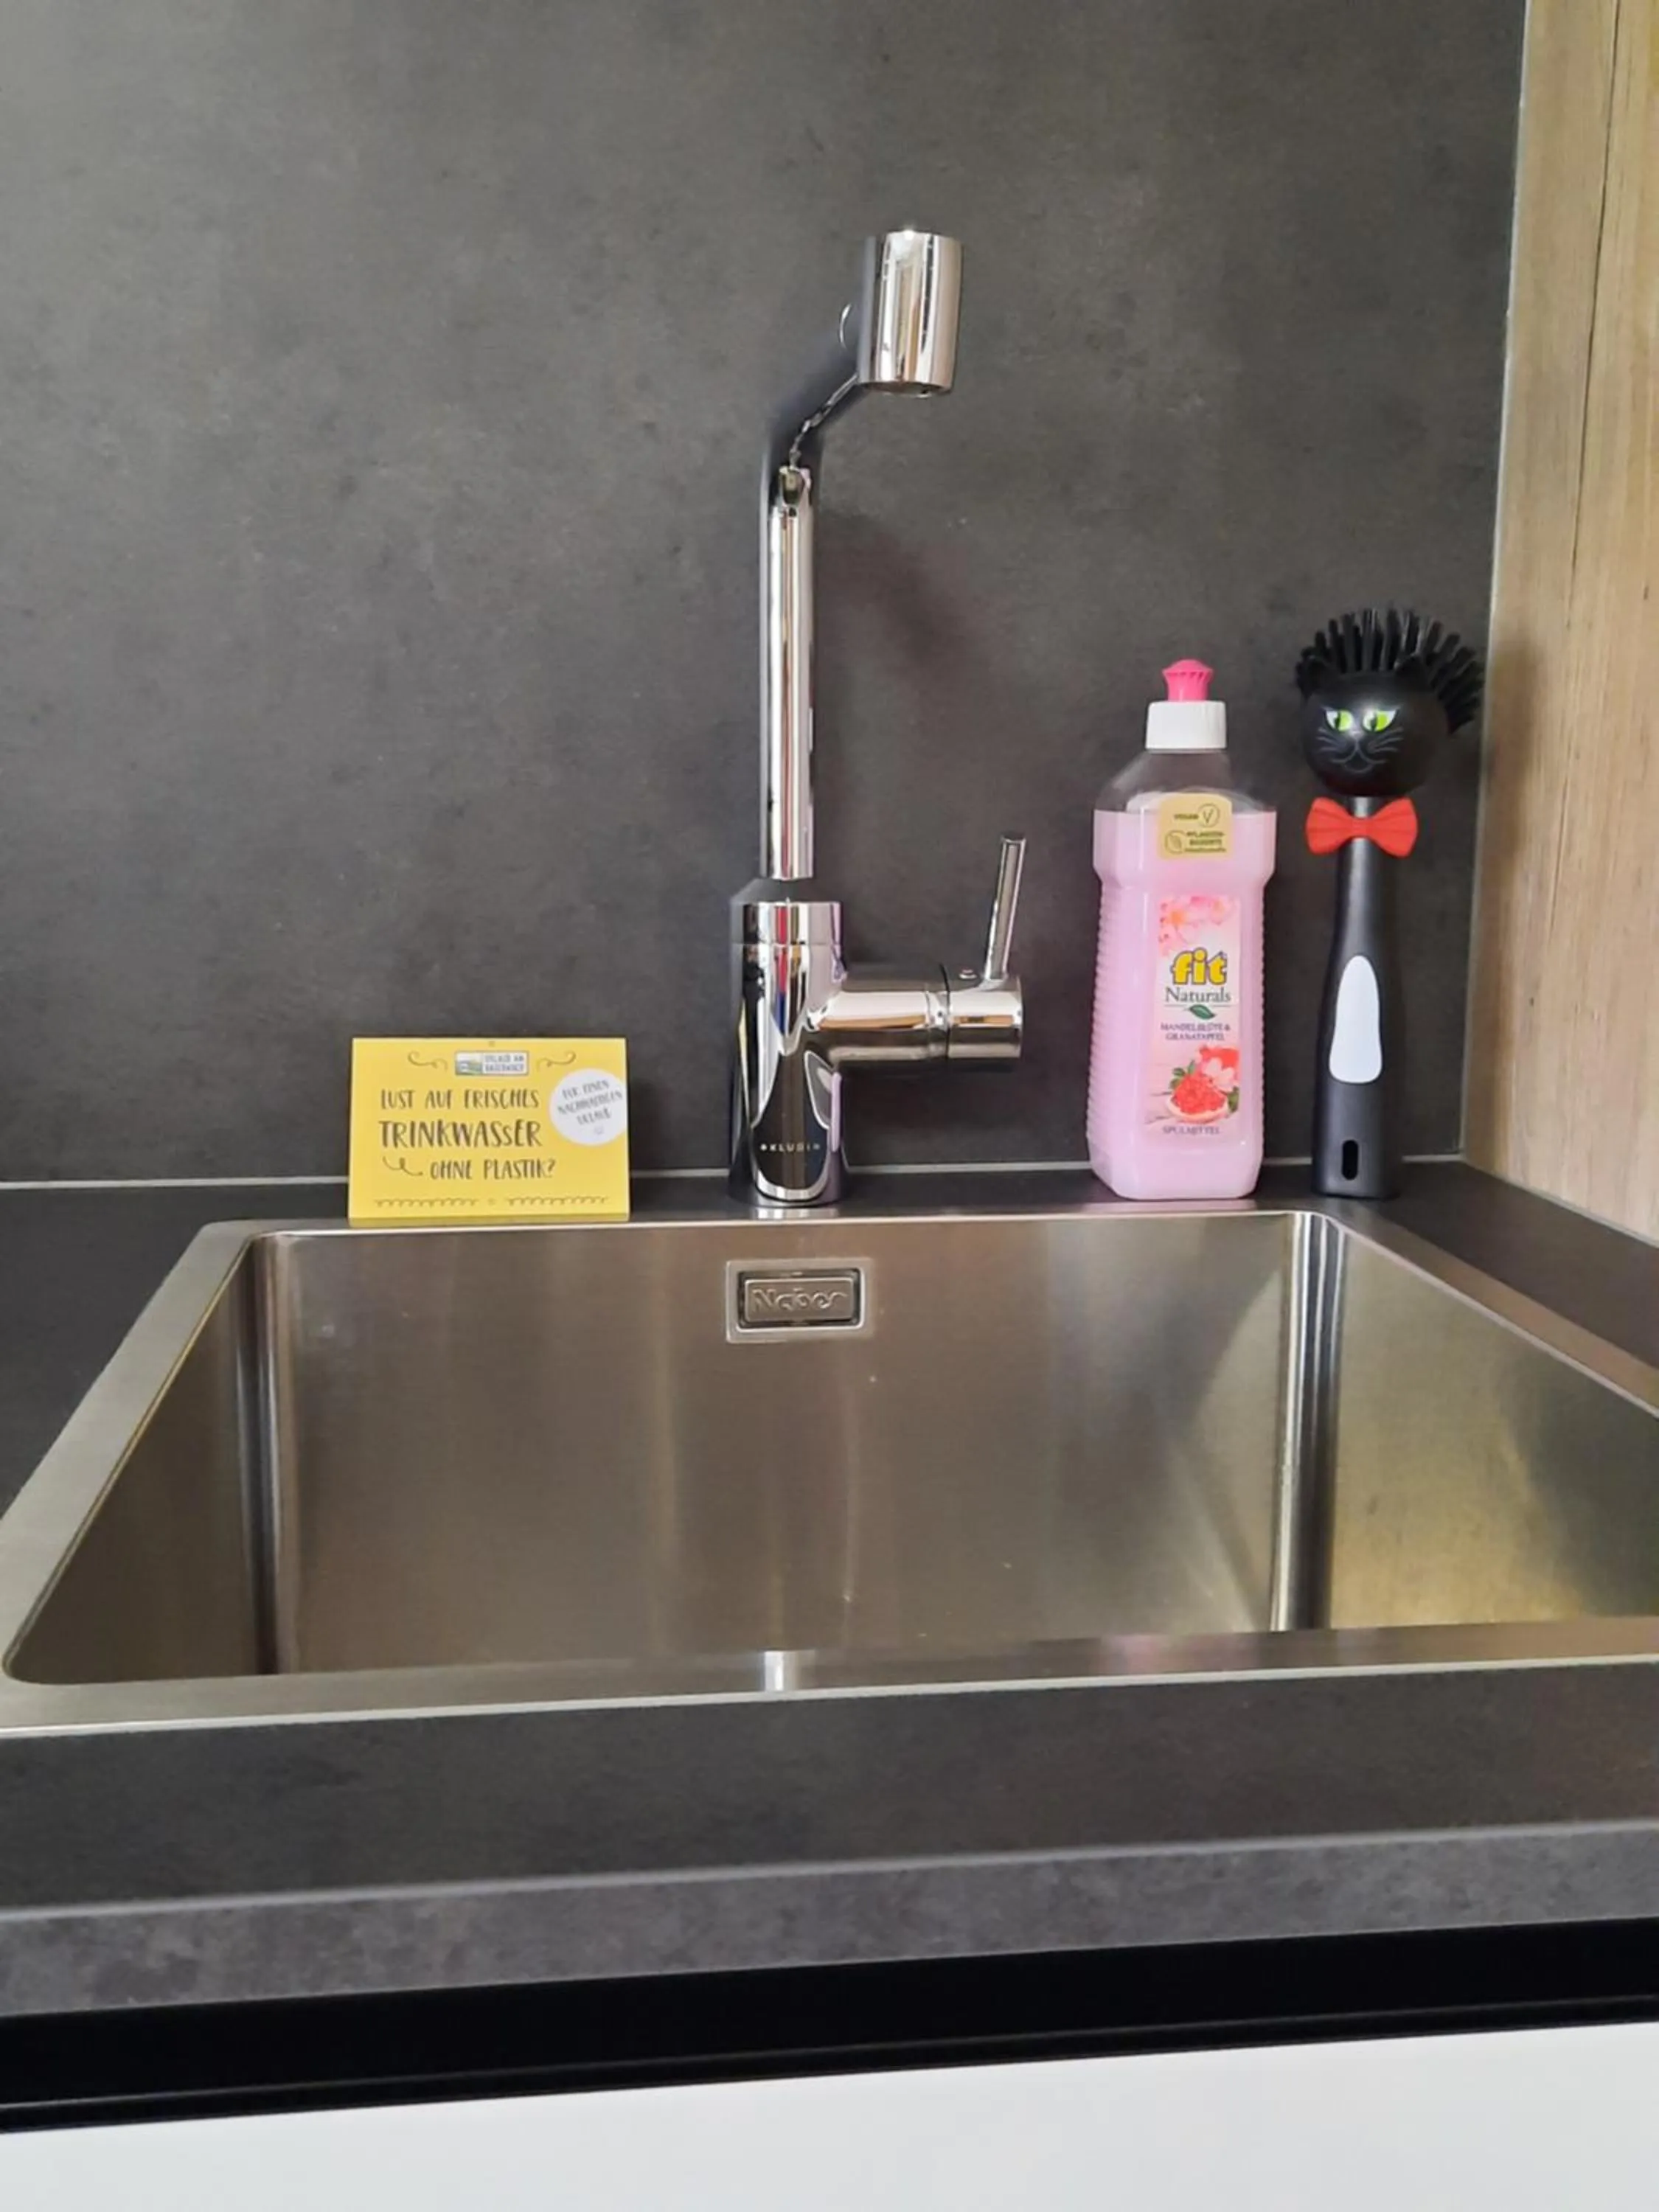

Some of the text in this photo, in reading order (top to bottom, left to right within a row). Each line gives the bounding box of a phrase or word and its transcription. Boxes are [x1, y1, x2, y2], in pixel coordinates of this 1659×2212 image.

[1170, 947, 1228, 985] fit
[1165, 987, 1231, 1003] Naturals
[380, 1088, 540, 1110] LUST AUF FRISCHES
[379, 1119, 543, 1149] TRINKWASSER
[430, 1158, 556, 1180] OHNE PLASTIK?
